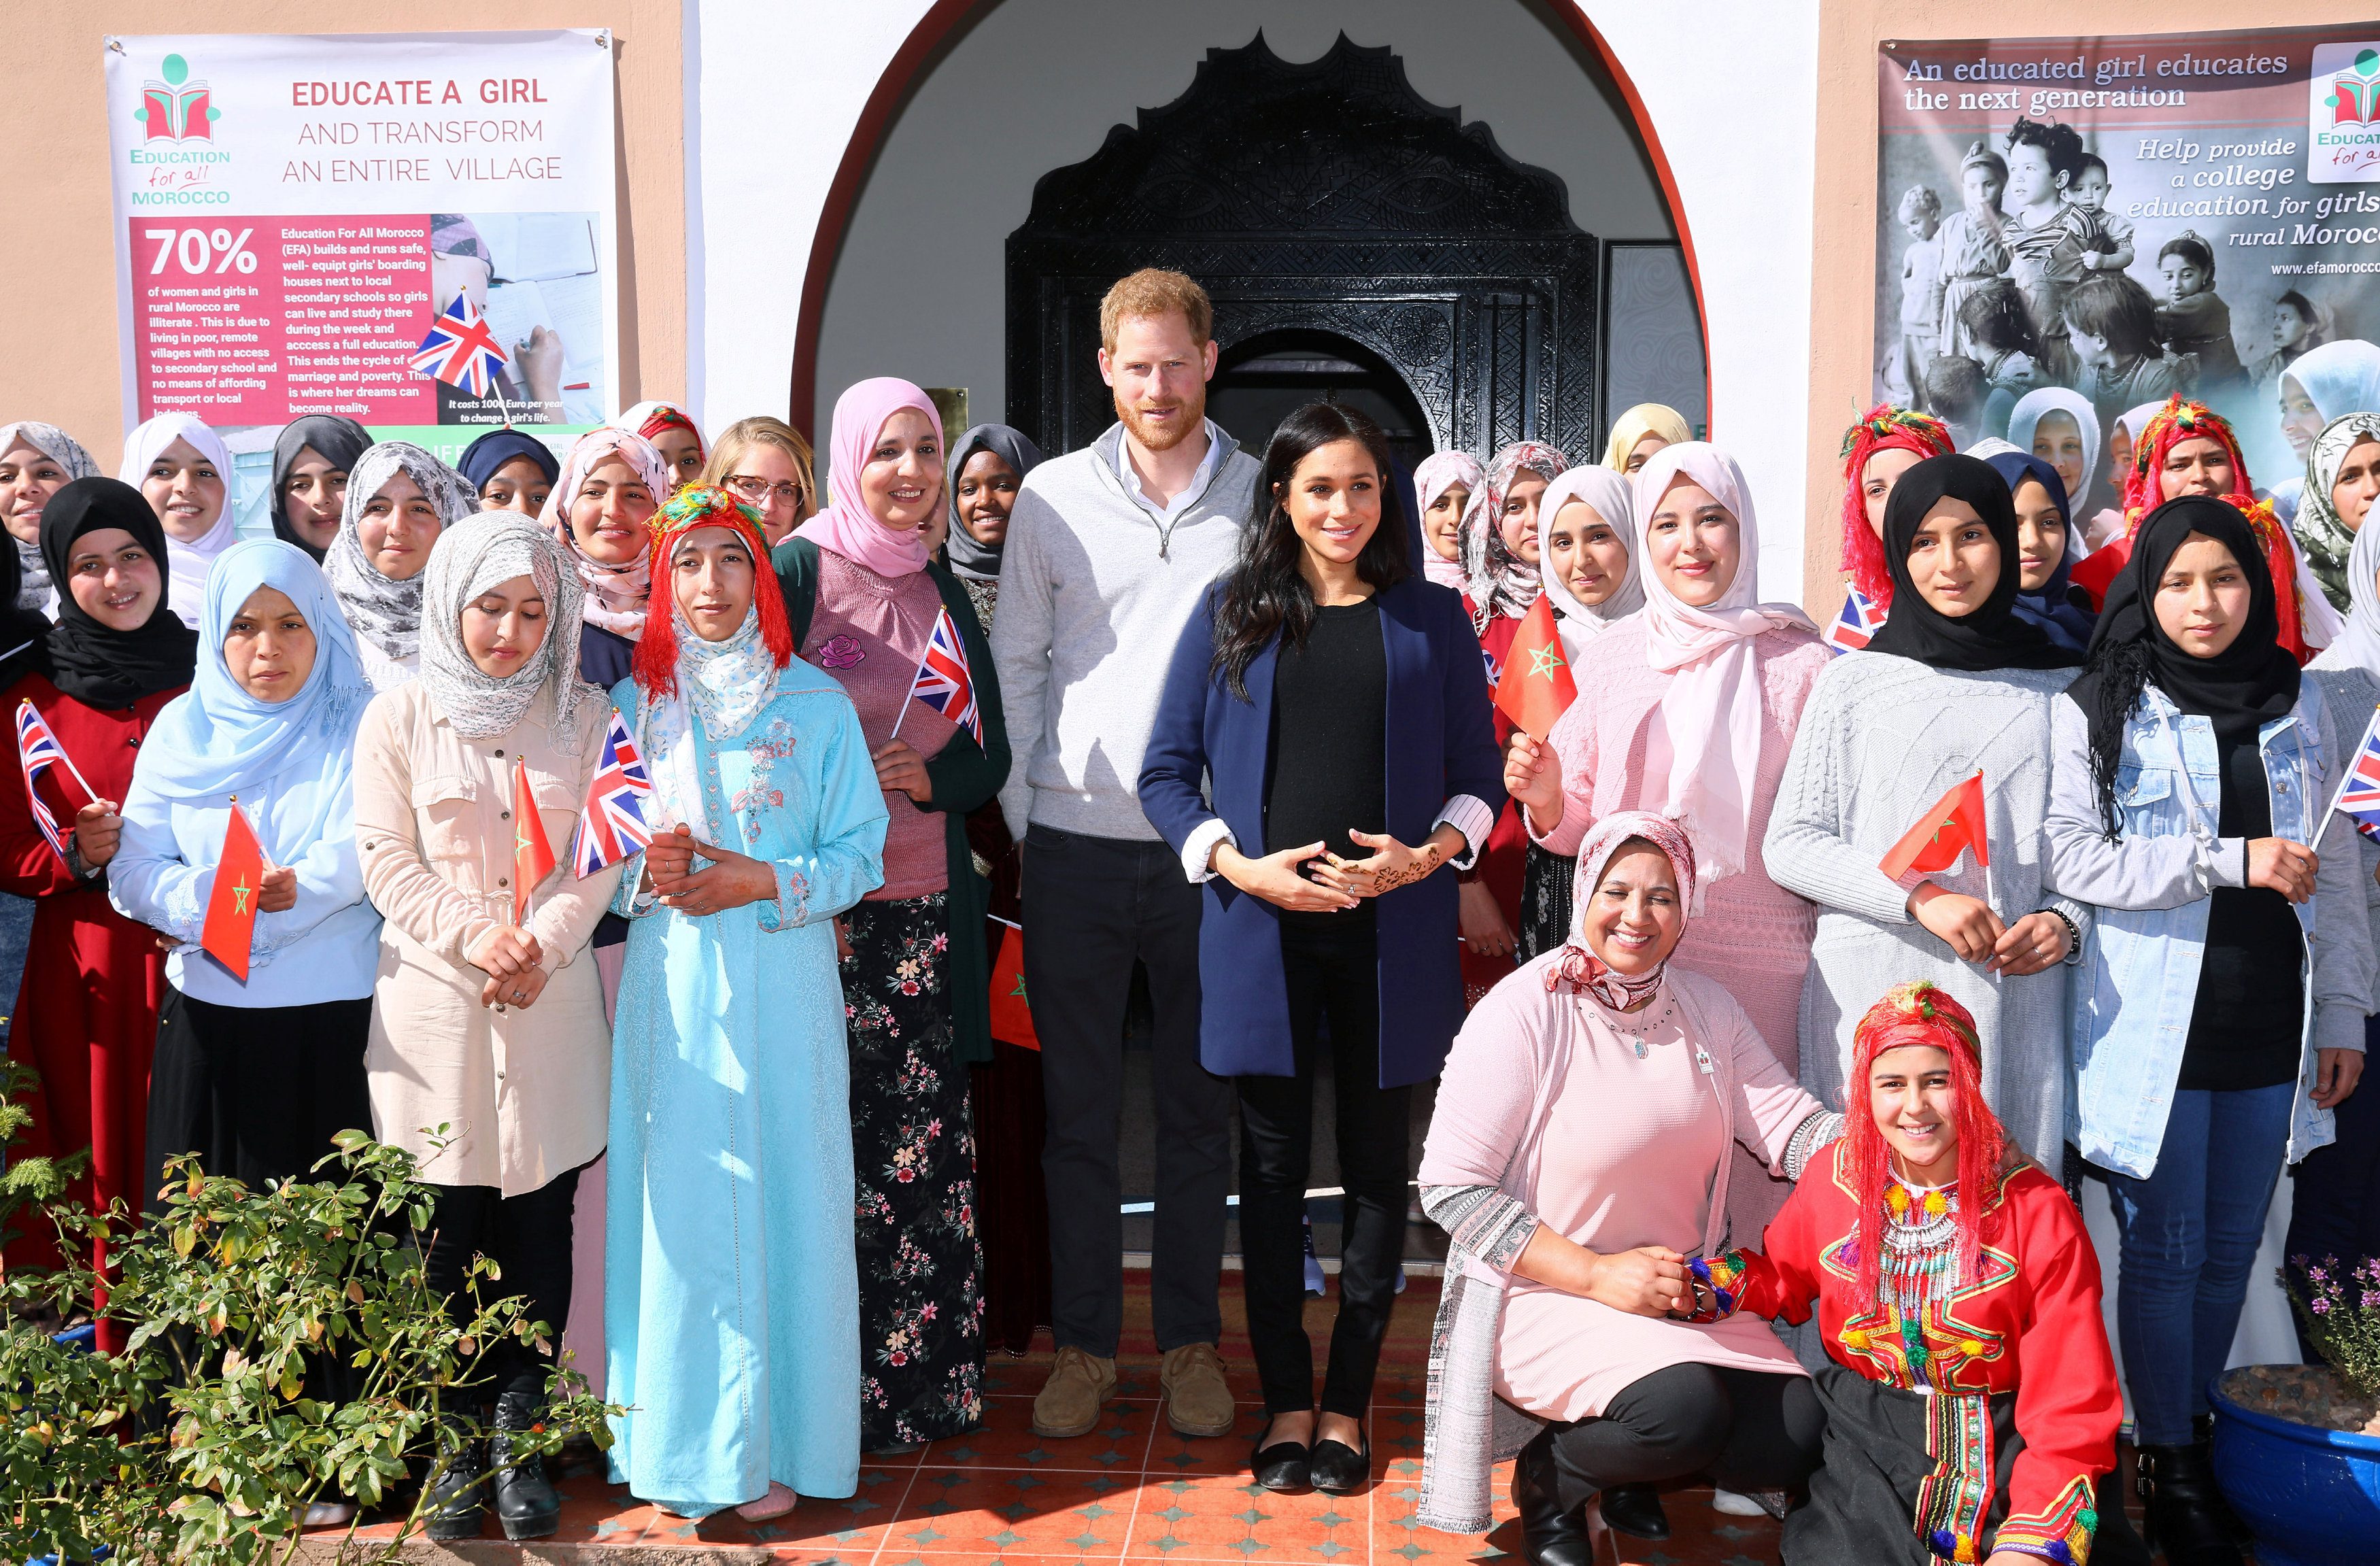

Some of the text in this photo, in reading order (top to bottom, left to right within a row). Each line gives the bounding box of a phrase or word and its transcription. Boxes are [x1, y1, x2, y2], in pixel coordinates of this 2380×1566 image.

[1903, 53, 2288, 85] An educated girl educates
[292, 79, 547, 106] EDUCATE A GIRL
[1904, 86, 2186, 116] the next generation
[298, 120, 542, 145] AND TRANSFORM
[2137, 138, 2296, 164] Help provide
[2332, 147, 2359, 165] for
[149, 165, 208, 187] for all
[282, 157, 562, 182] AN ENTIRE VILLAGE
[2171, 165, 2295, 190] a college
[132, 191, 231, 205] MOROCCO
[2127, 191, 2380, 219] education for girls
[282, 228, 424, 239] Education For All Morocco
[2229, 224, 2380, 246] rural Moroc
[145, 228, 258, 274] 70%
[282, 243, 426, 257] (EFA) builds and runs safe,
[283, 259, 426, 272] well- equipt girls' boarding
[284, 275, 392, 286] houses next to local
[148, 286, 258, 299] of women and girls in
[284, 292, 341, 305] secondary
[343, 292, 385, 302] schools
[404, 291, 428, 303] girls
[149, 303, 173, 312] rural
[175, 303, 220, 311] Morocco
[285, 307, 413, 320] can live and study there
[150, 318, 192, 327] illiterate
[201, 317, 223, 326] This
[226, 317, 235, 326] is
[237, 317, 257, 326] due
[260, 318, 269, 326] to
[286, 324, 394, 336] during the week and
[150, 333, 258, 345] living in poor, remote
[286, 339, 419, 350] acccess a full education.
[151, 348, 190, 360] villages
[194, 347, 215, 357] with
[287, 356, 311, 366] This
[313, 356, 339, 365] ends
[342, 355, 360, 365] the
[362, 355, 390, 367] cycle
[393, 355, 405, 364] of
[152, 362, 277, 375] to secondary school and
[169, 380, 203, 388] means
[205, 378, 216, 388] of
[219, 378, 266, 390] affording
[288, 371, 431, 384] marriage and poverty. This
[288, 387, 419, 397] is where her dreams can
[153, 393, 241, 405] transport or local
[506, 400, 526, 408] Euro
[289, 403, 371, 415] become reality.
[460, 414, 469, 422] to
[471, 413, 503, 424] change
[511, 413, 532, 424] girl's
[534, 413, 550, 423] life.
[422, 445, 466, 462] IFE
